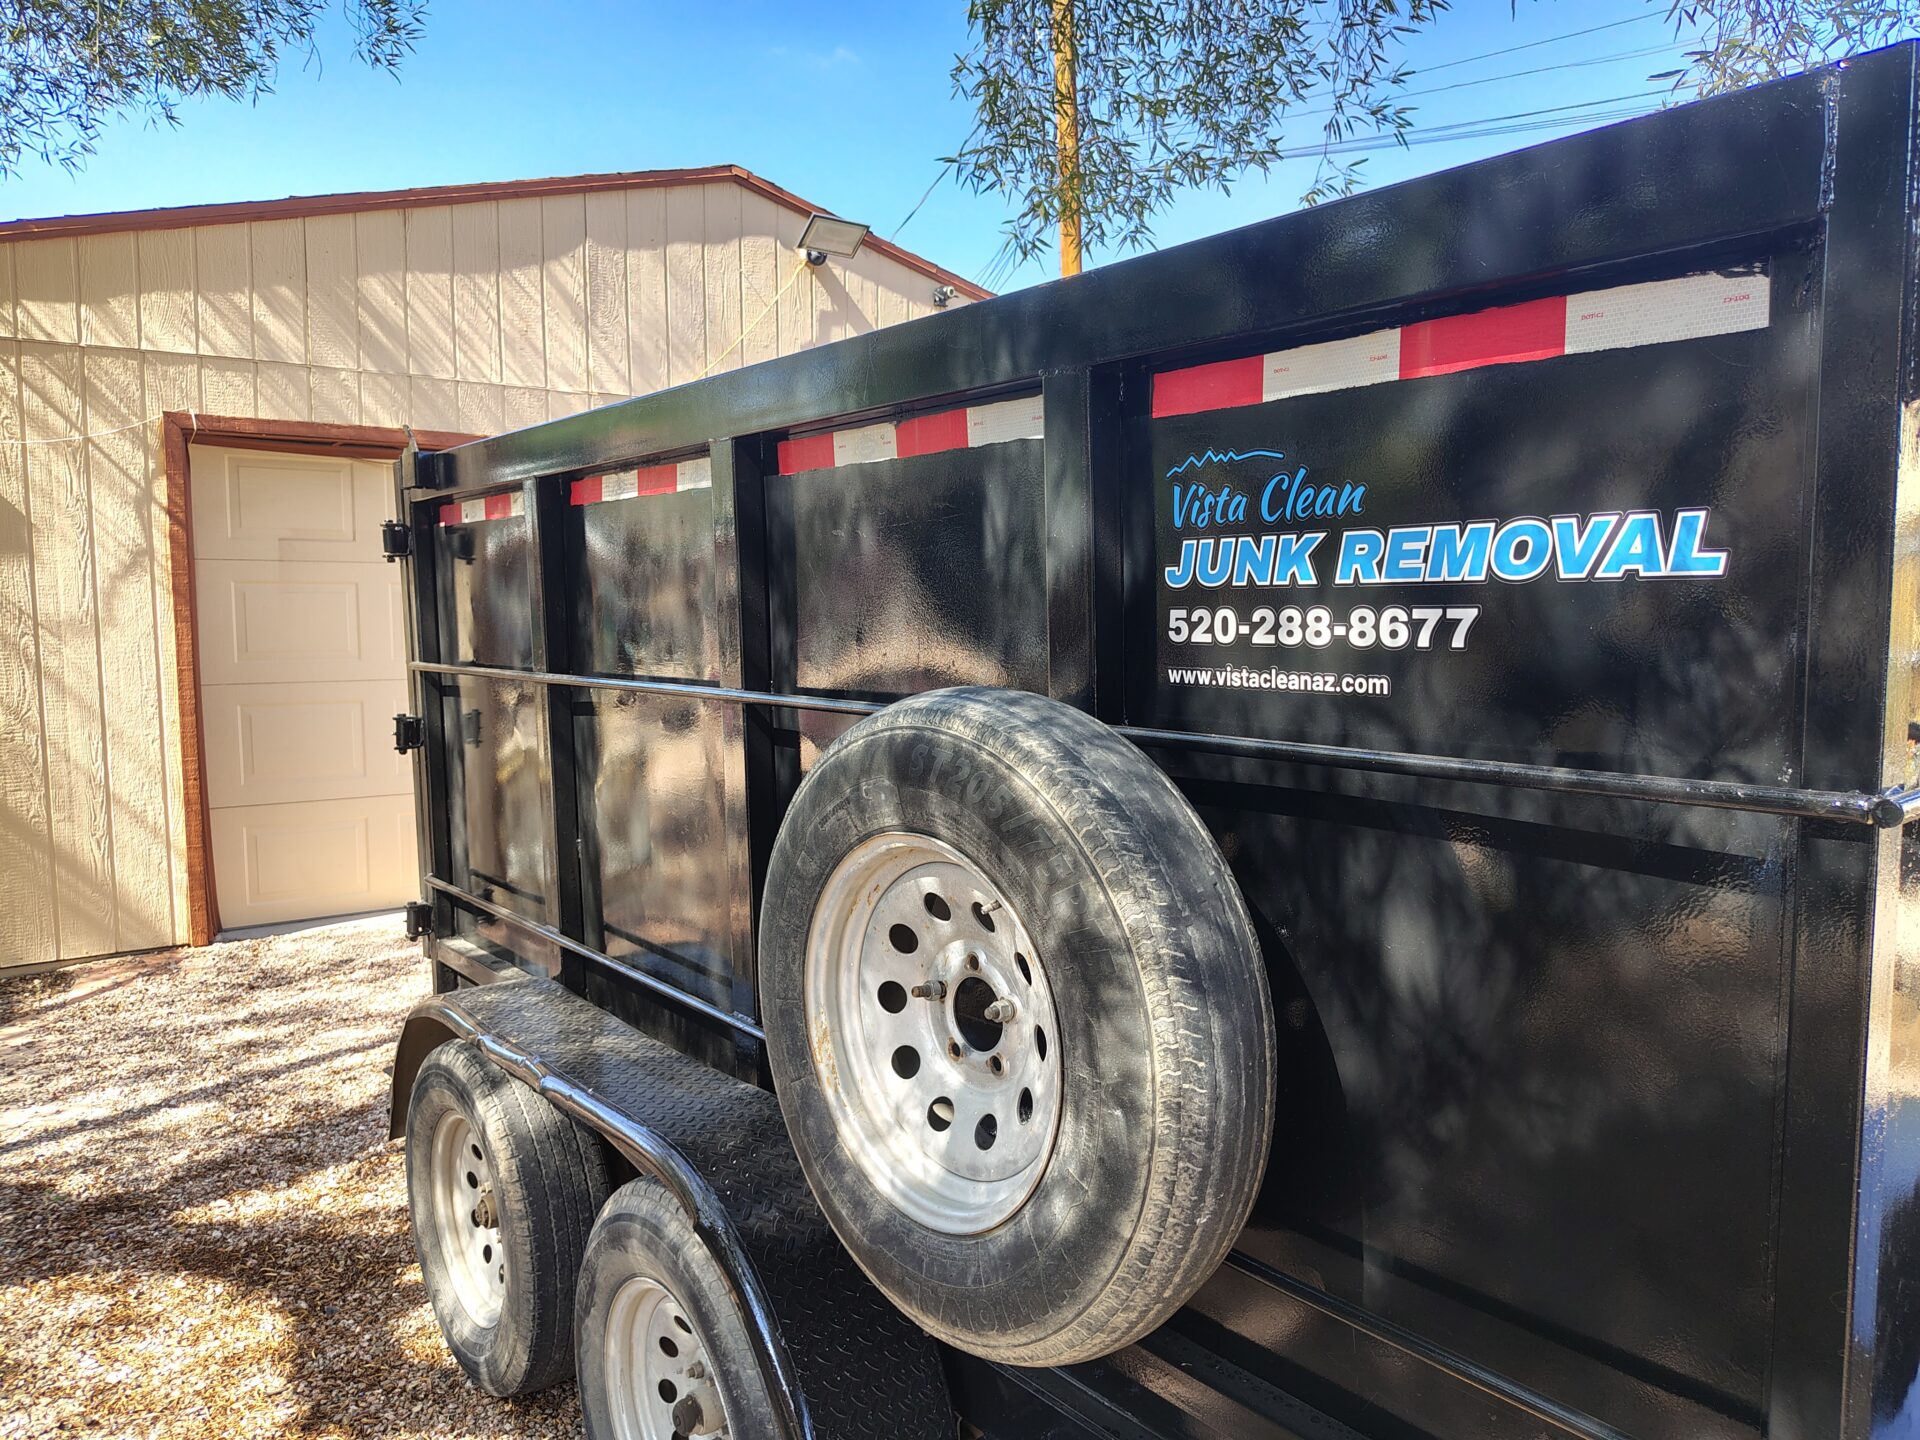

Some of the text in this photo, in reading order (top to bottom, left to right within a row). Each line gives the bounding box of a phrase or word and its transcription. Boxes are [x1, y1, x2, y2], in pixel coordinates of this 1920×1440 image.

[1173, 466, 1367, 528] Vista Clean
[1165, 510, 1727, 588] JUNK REMOVAL
[1168, 607, 1479, 649] 520-288-8677
[1168, 664, 1389, 695] www.vistacleanaz.com
